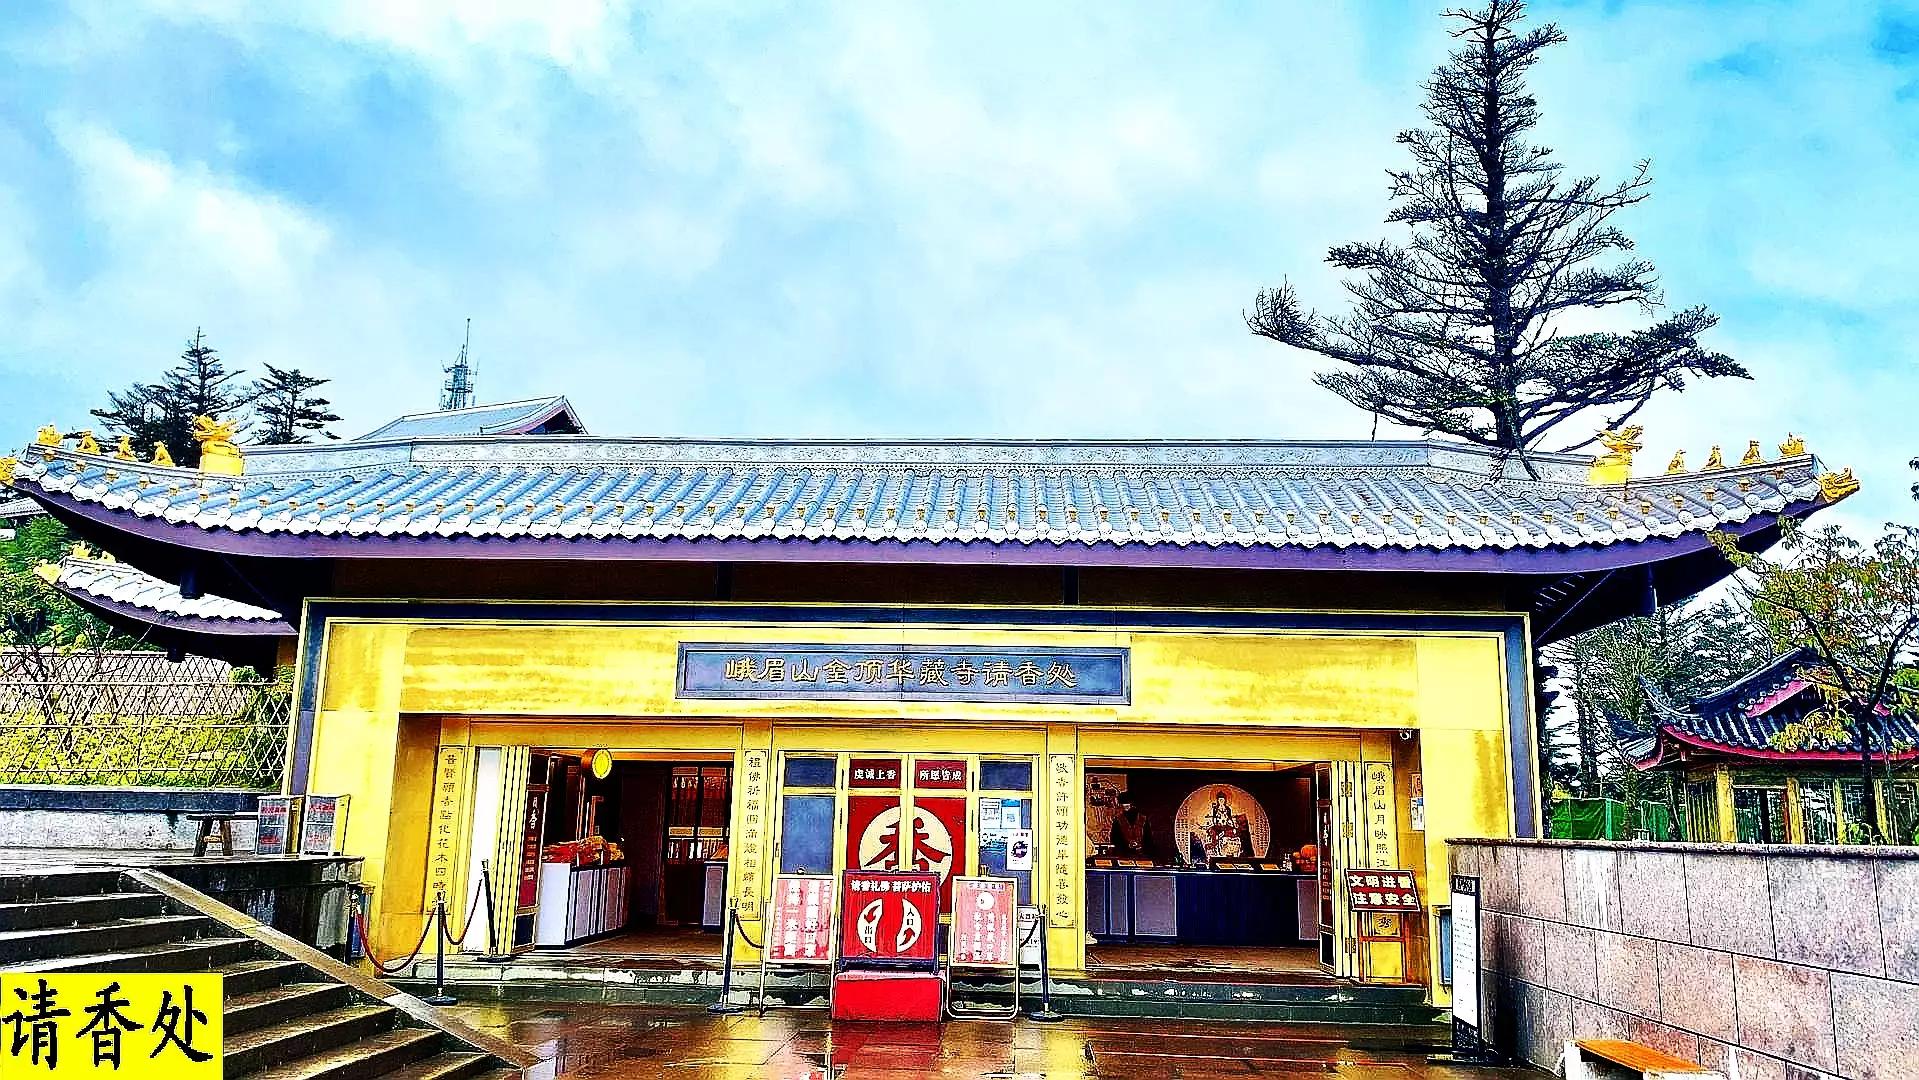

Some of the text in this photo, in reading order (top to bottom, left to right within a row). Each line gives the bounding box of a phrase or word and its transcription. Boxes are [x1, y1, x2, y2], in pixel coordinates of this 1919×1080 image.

[724, 657, 1079, 688] 峨眉山金顶华藏寺请香处
